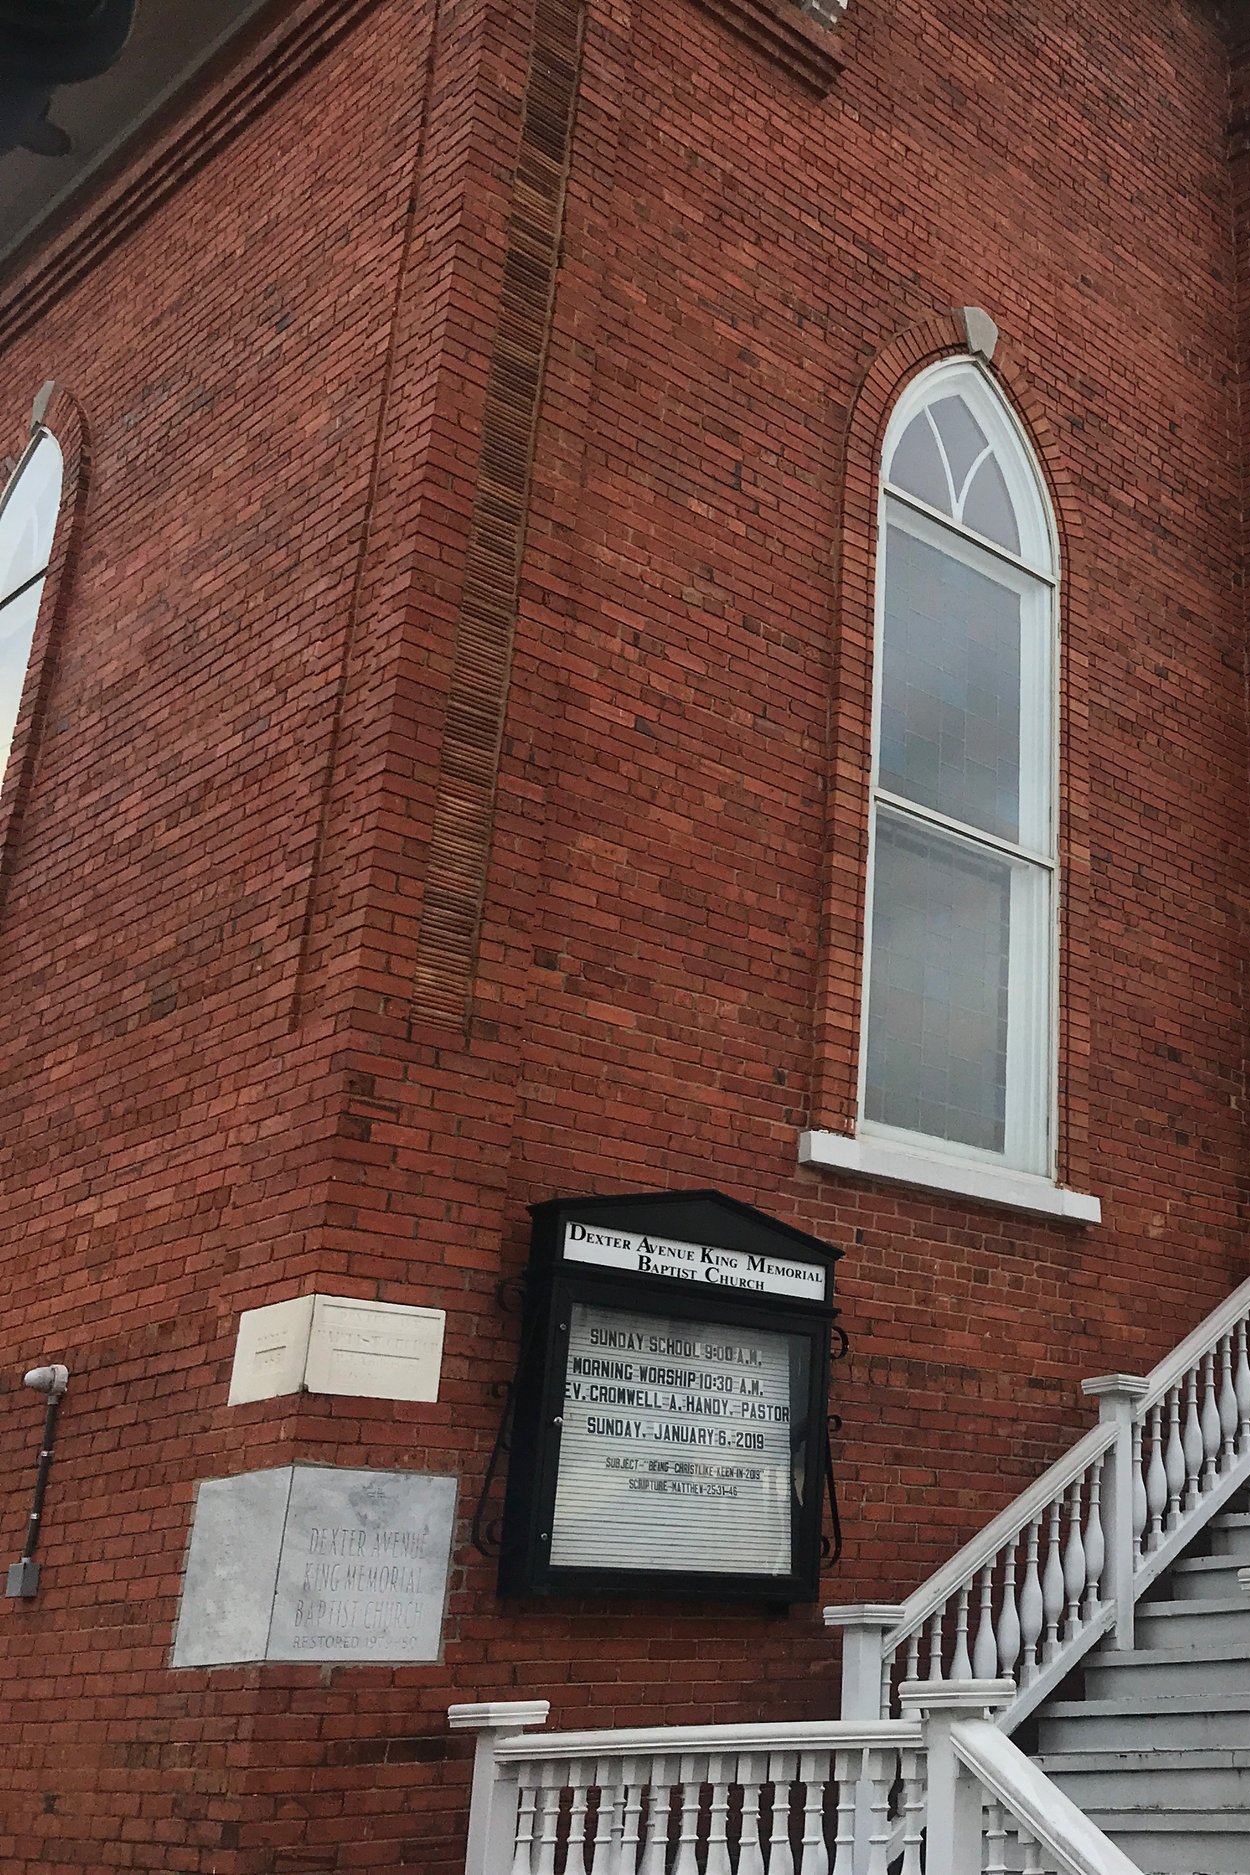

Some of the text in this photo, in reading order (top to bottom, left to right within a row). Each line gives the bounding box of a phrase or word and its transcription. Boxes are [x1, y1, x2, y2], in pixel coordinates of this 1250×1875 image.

[569, 1223, 823, 1283] DEXTER AVENUE KING MEMORIAL
[638, 1254, 765, 1290] BAPTIST CHURCH
[590, 1328, 762, 1366] SUNDAY SCHOOL 9:00 A.M.
[573, 1357, 763, 1396] MORNING WORSHIP 10:30 A.M.
[564, 1382, 789, 1422] EV. CROMWELL A. HANDY, PASTOR
[587, 1417, 646, 1438] SUNDAY,
[654, 1423, 714, 1445] JANUARY
[736, 1432, 764, 1449] 2019
[309, 1527, 427, 1559] DEXTER AVENUE
[303, 1562, 422, 1594] KING MEMORIAL
[294, 1599, 423, 1630] BAPTIST CHURCH
[292, 1635, 359, 1649] RESTORED
